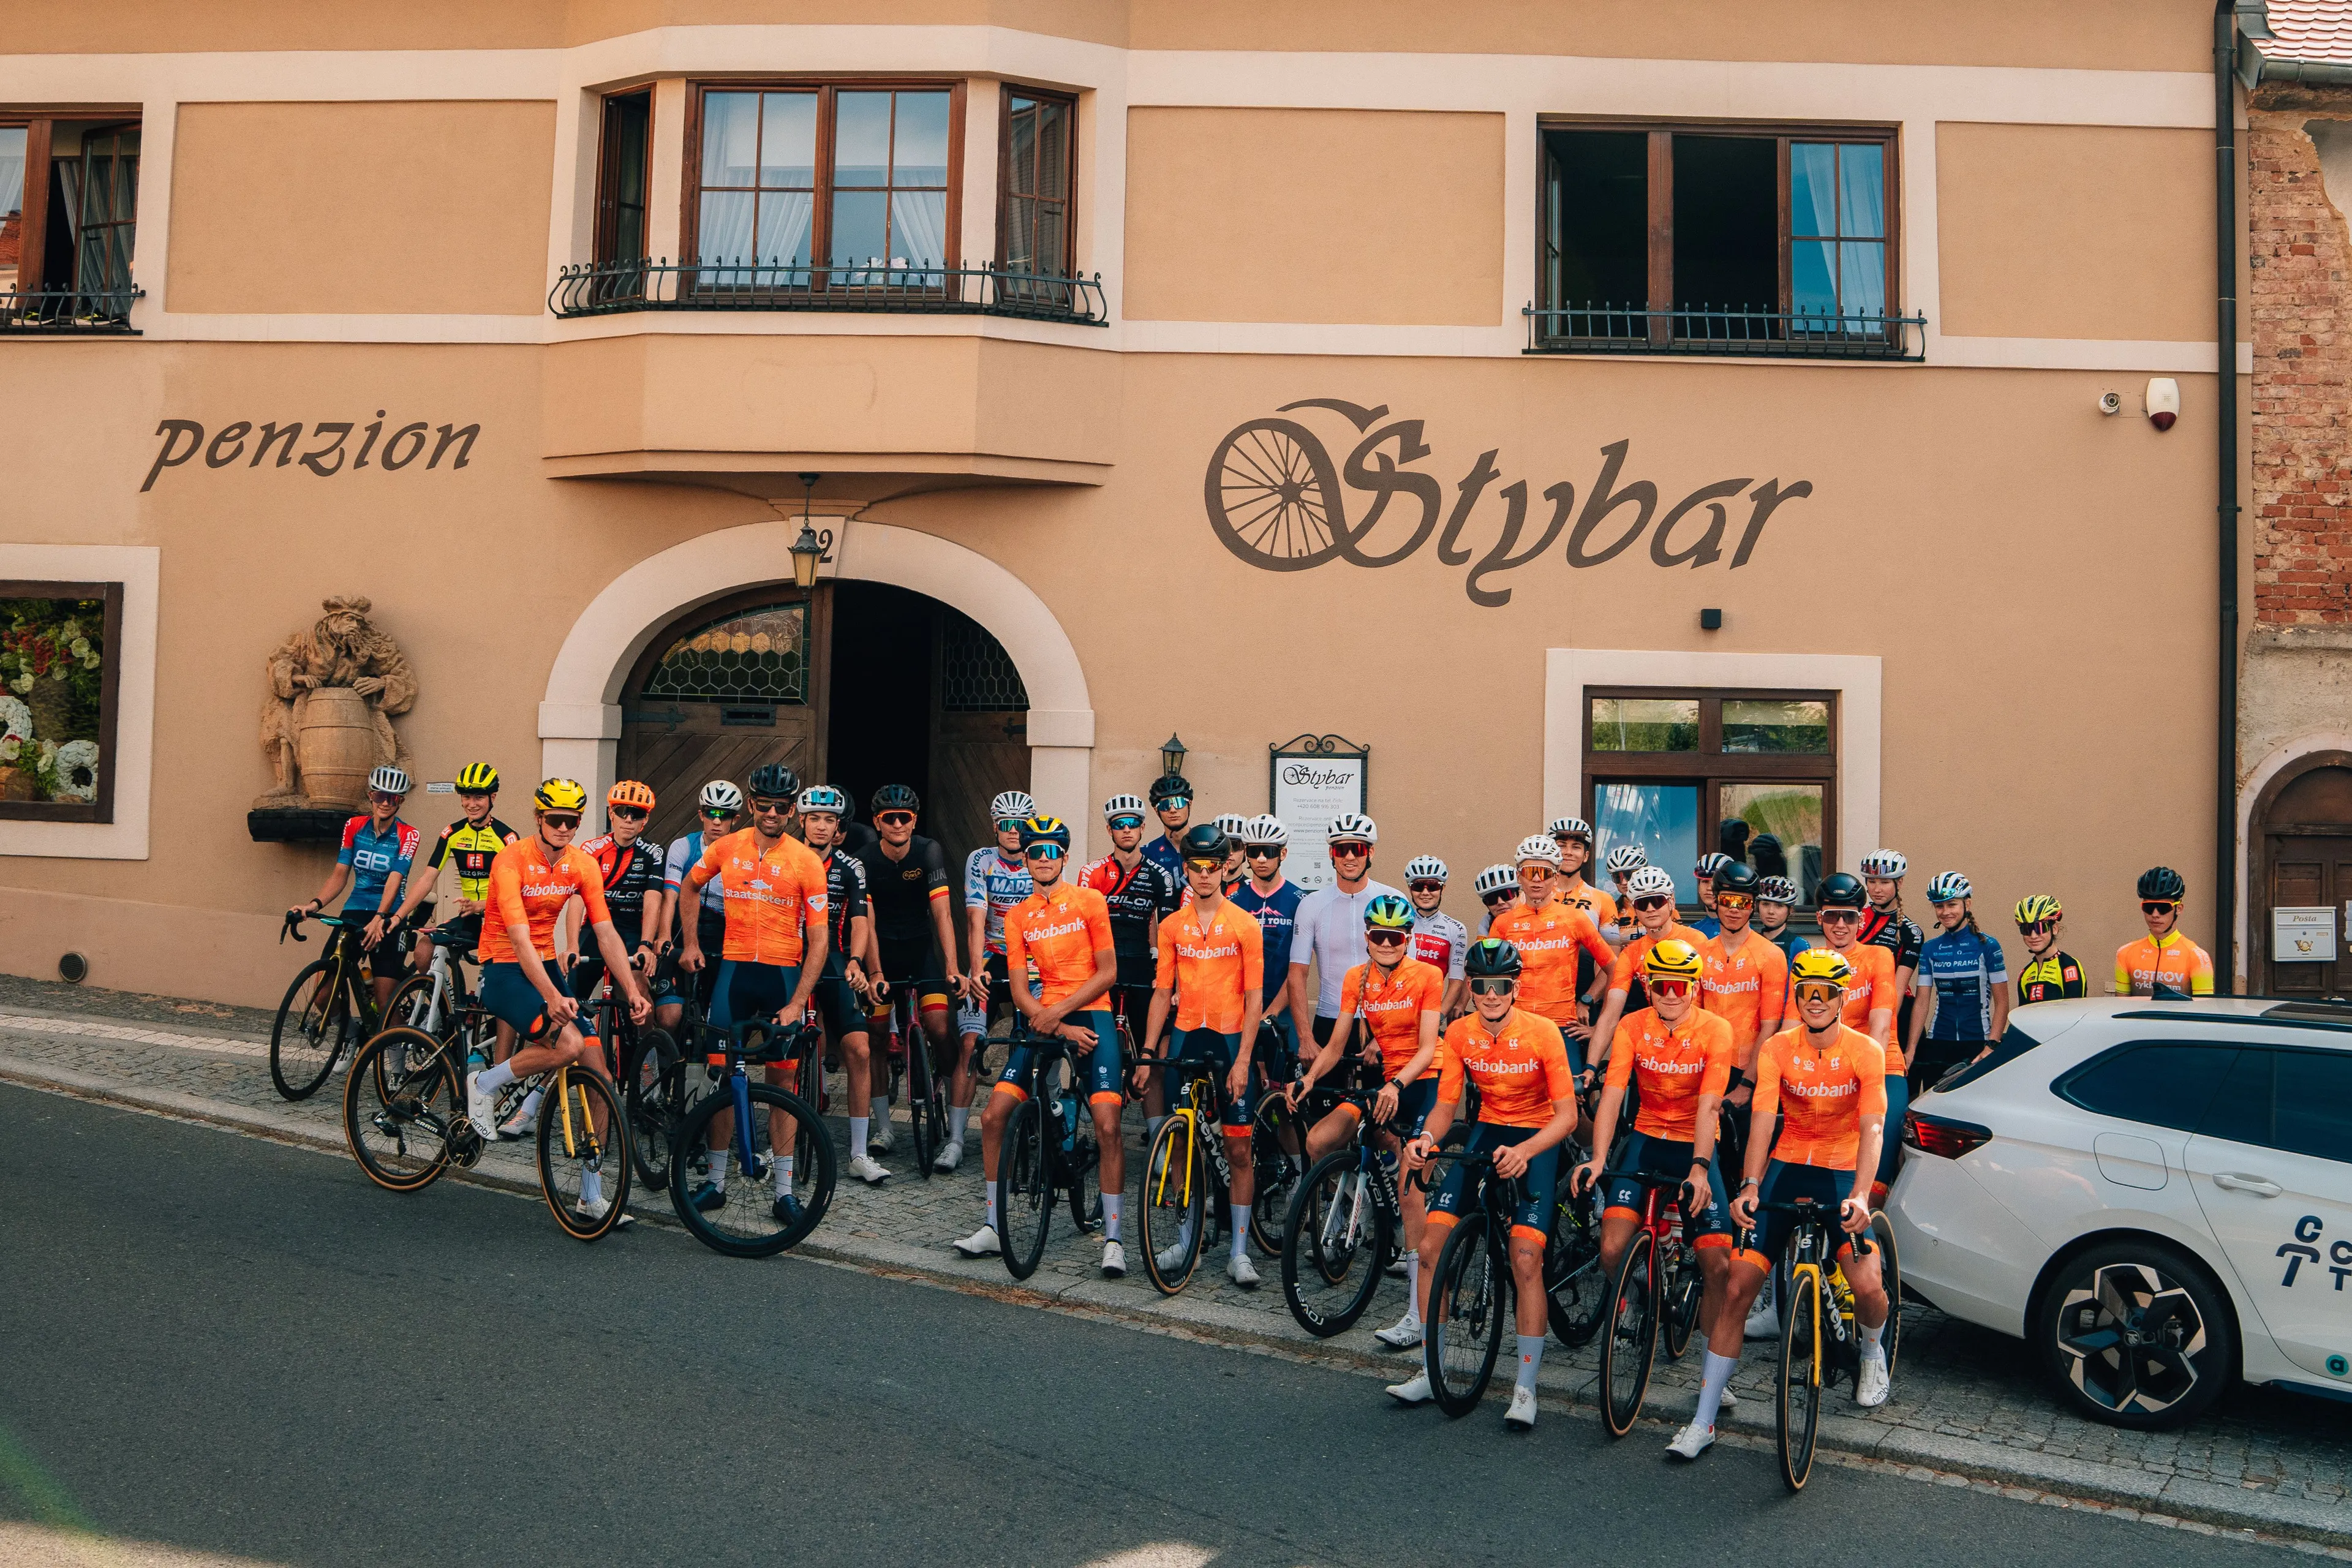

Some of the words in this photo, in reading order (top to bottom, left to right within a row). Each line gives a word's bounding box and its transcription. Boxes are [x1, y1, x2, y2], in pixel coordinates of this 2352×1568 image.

[139, 409, 481, 492] penzion
[1204, 398, 1813, 607] Stybar
[1283, 764, 1354, 789] Stybar
[636, 837, 663, 865] brilon
[835, 850, 866, 889] brilon
[928, 867, 947, 884] DUK
[1146, 859, 1173, 897] brilon
[521, 882, 578, 897] Rabobank
[991, 877, 1033, 893] MAPE
[725, 889, 793, 907] Staatsloterij
[992, 895, 1029, 904] MERI
[1023, 917, 1085, 942] Rabobank
[1268, 918, 1293, 926] TOUR
[1444, 916, 1464, 932] RE/MAX
[1902, 916, 1922, 944] rilon
[1176, 943, 1238, 959] Rabobank
[2133, 969, 2184, 983] OSTROV
[1700, 976, 1760, 995] abobank
[1364, 996, 1414, 1012] Rabobank
[1464, 1058, 1539, 1074] Rabobank
[1782, 1078, 1858, 1098] Rabobank
[414, 1119, 438, 1133] SRAM
[1263, 1182, 1279, 1196] SRAM
